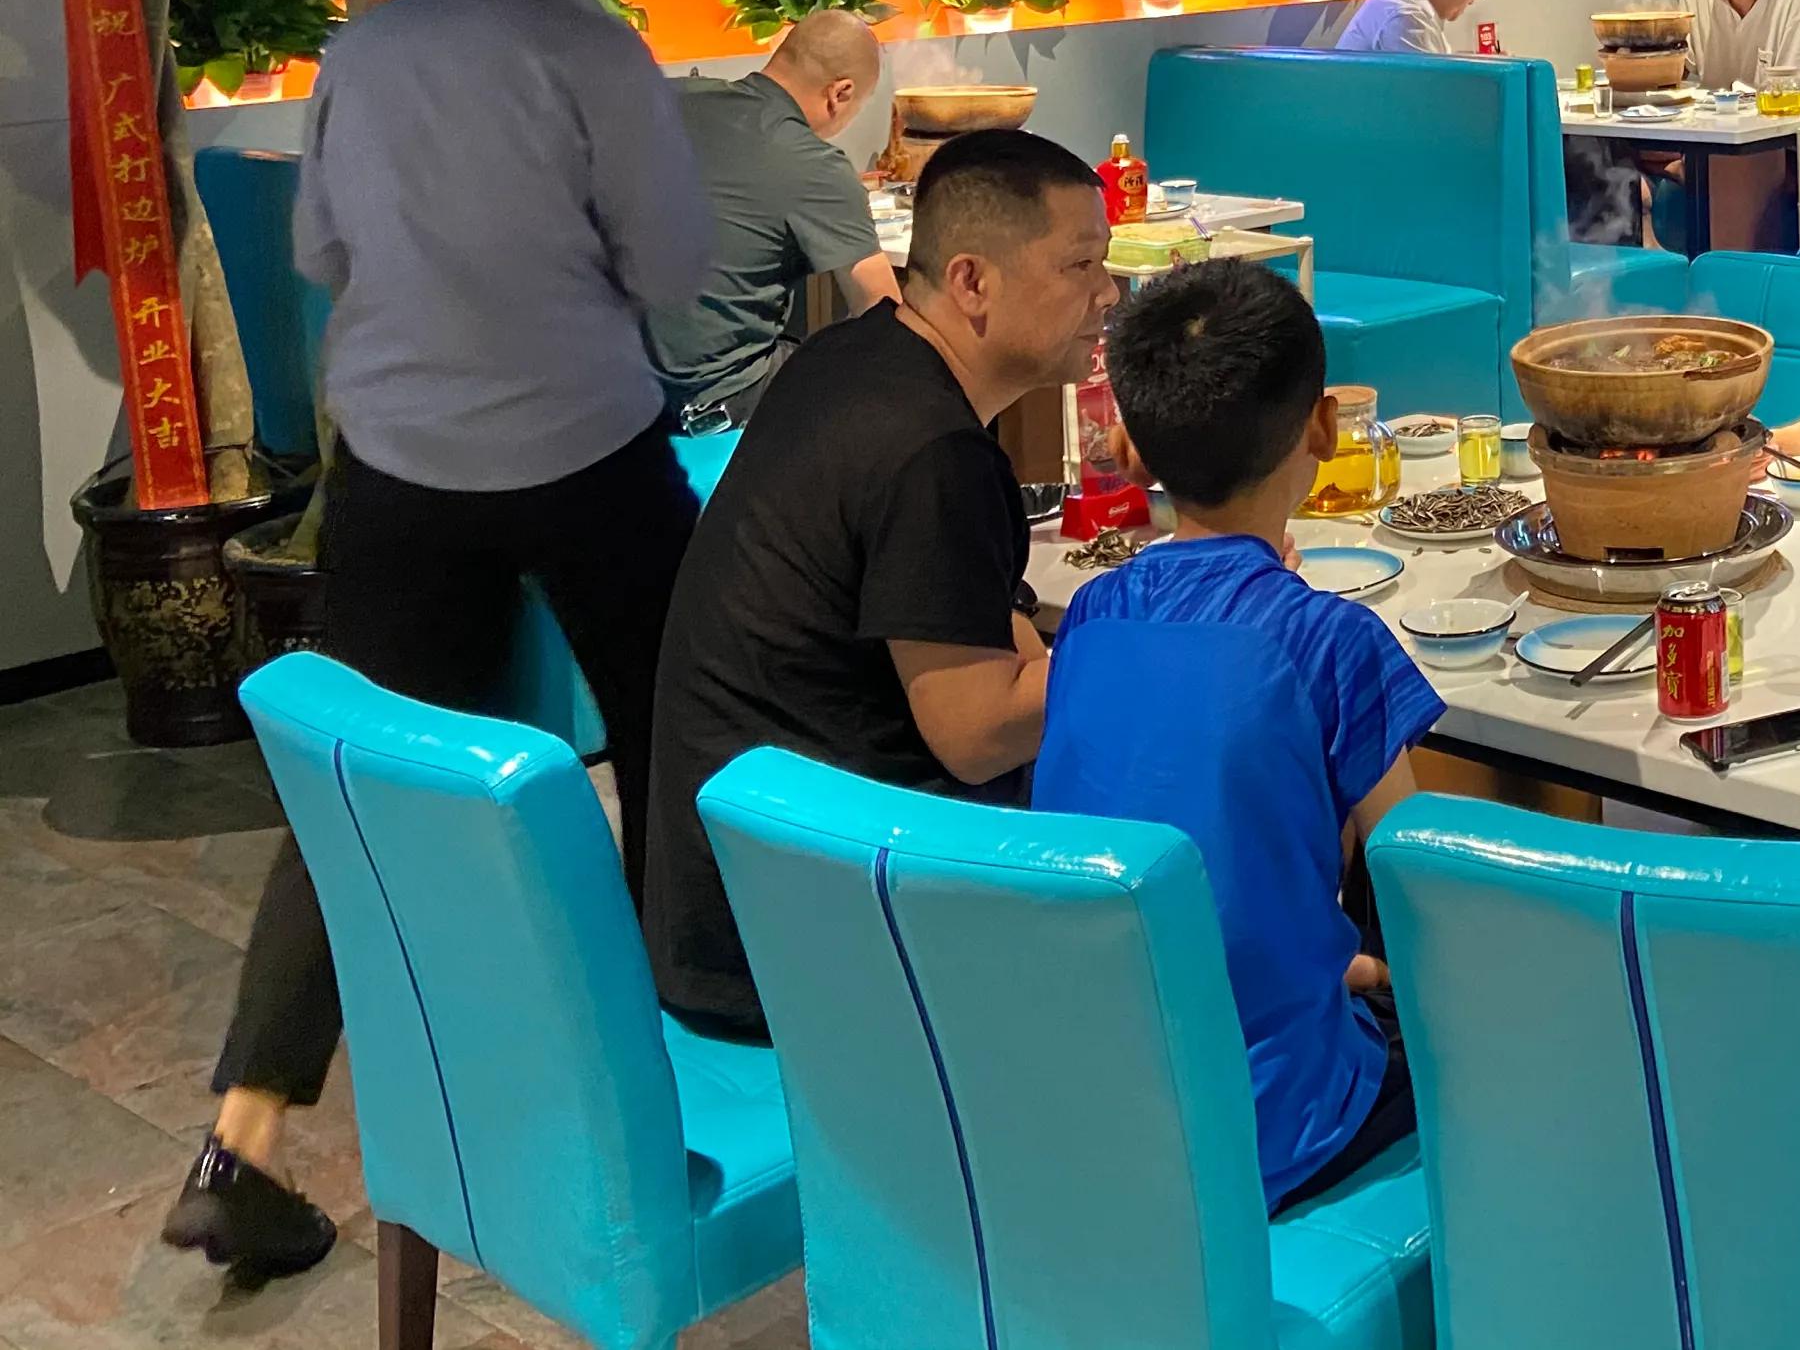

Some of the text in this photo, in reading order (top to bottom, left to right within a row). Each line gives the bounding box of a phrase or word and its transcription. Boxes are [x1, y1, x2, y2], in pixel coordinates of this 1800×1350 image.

[93, 9, 183, 450] 祝 广式打边炉 开业大吉
